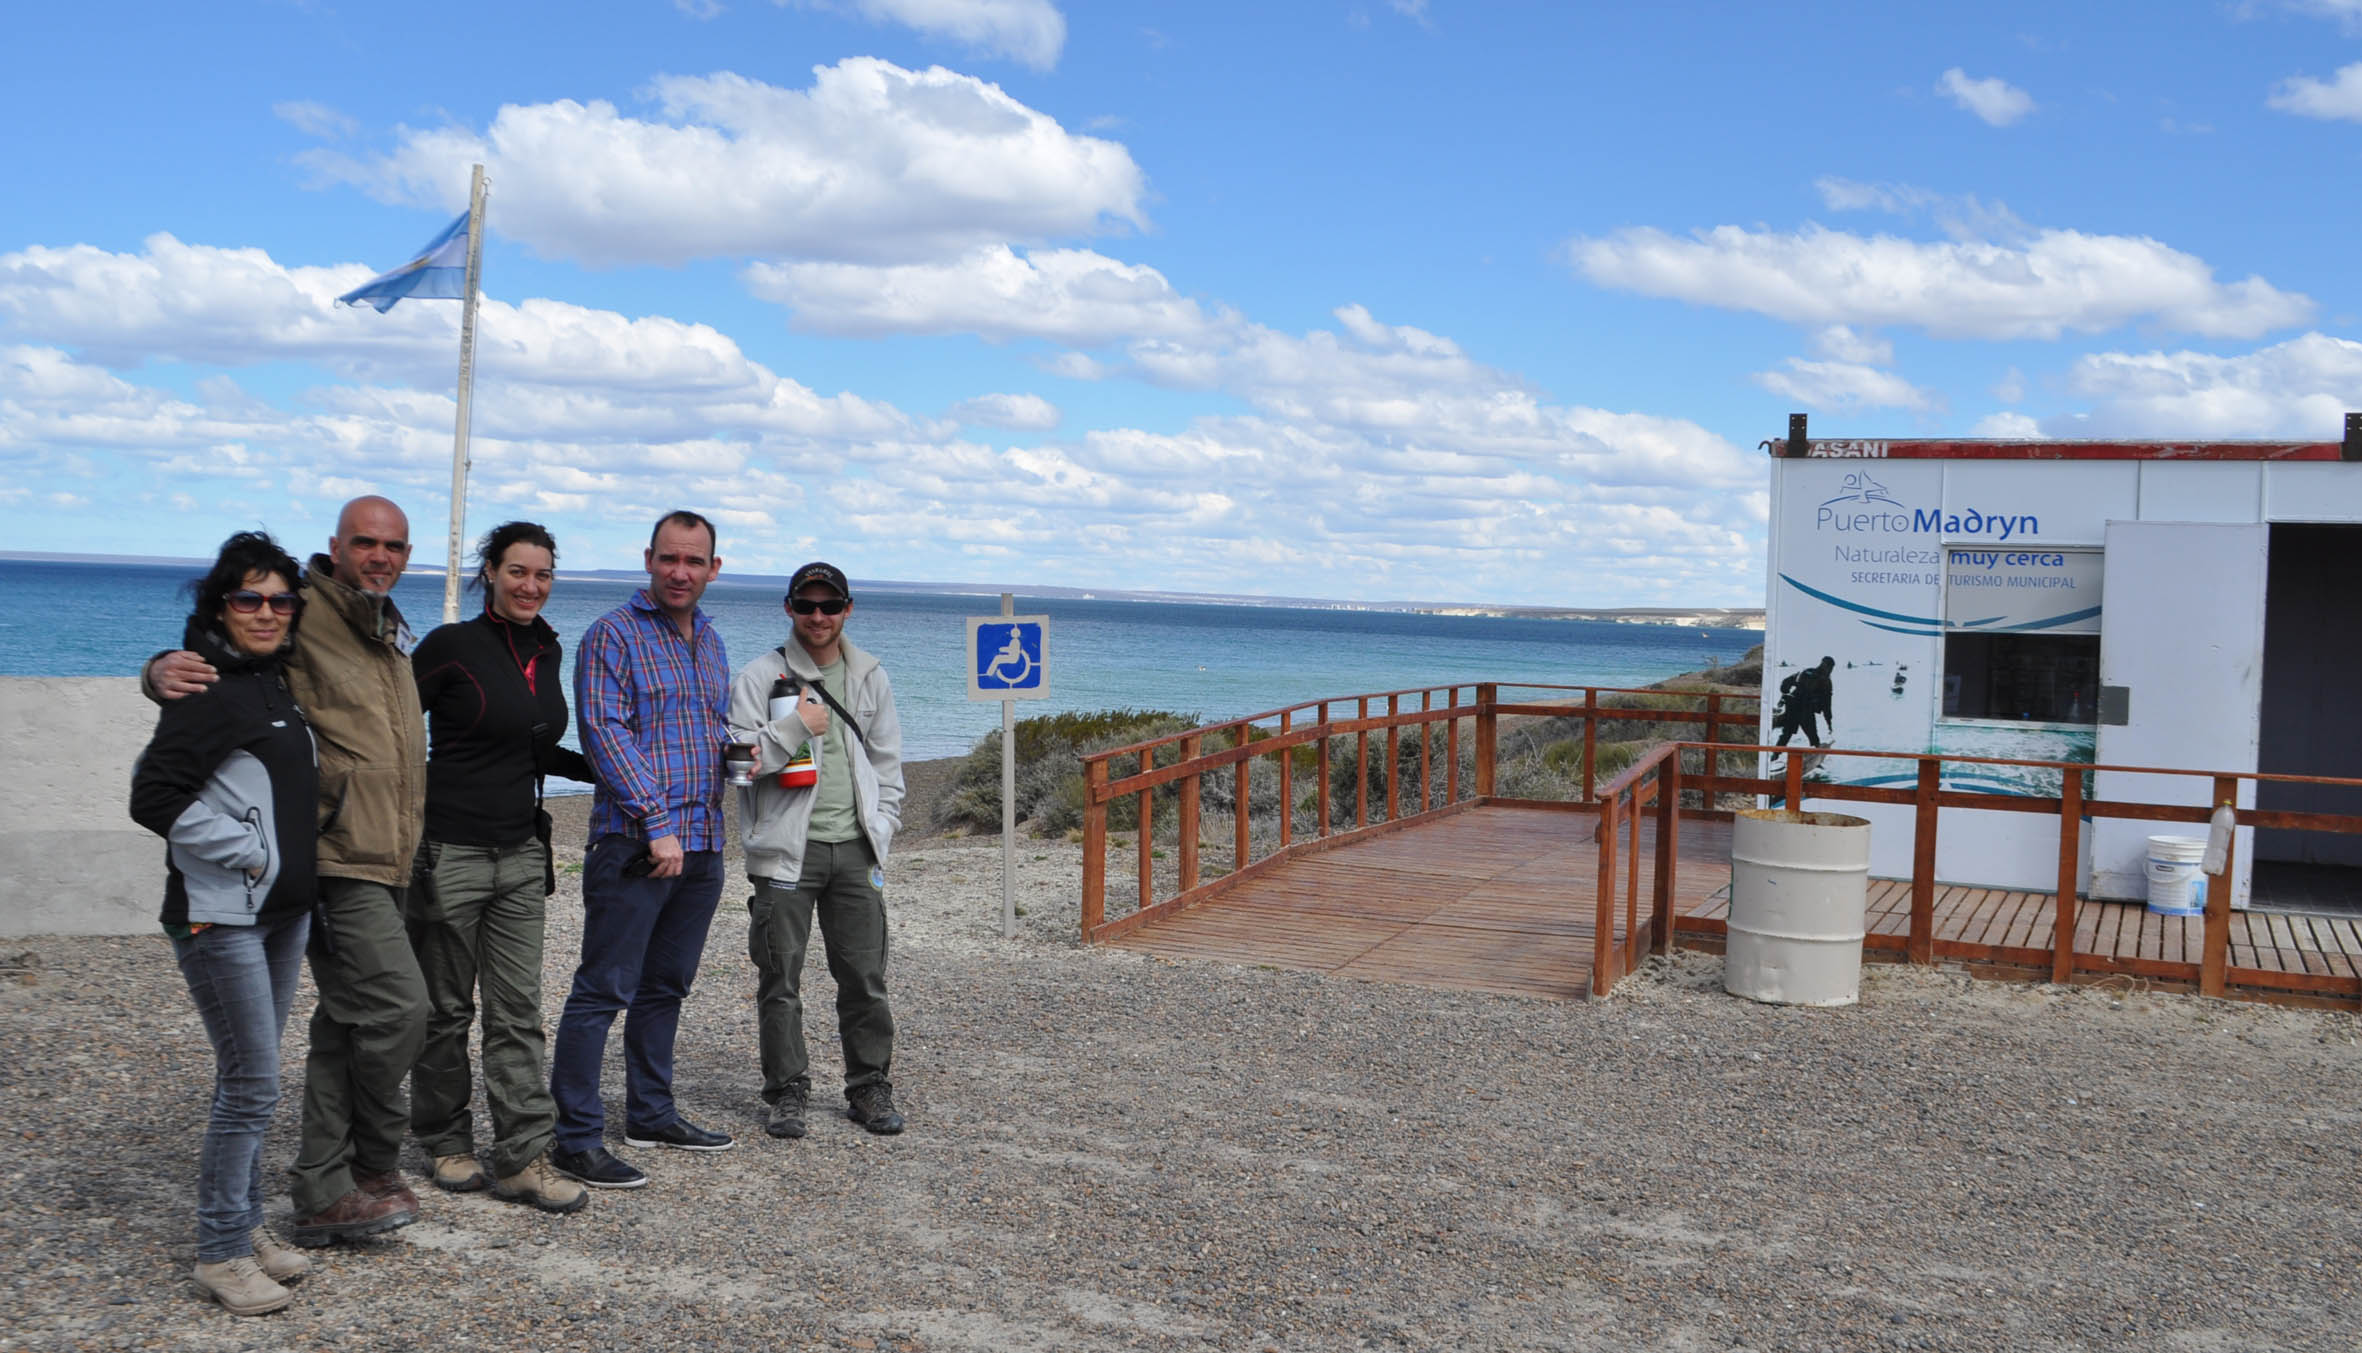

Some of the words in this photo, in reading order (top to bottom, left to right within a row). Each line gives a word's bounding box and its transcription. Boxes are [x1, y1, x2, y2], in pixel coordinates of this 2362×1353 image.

[1808, 441, 1888, 458] ASANI
[1834, 546, 1940, 564] Naturaleza
[1950, 552, 1999, 569] muy
[2005, 552, 2065, 567] cerca
[1851, 571, 1920, 585] SECRETARIA
[1925, 573, 1940, 585] DE
[1948, 574, 2003, 588] TURISMO
[2006, 575, 2077, 589] MUNICIPAL
